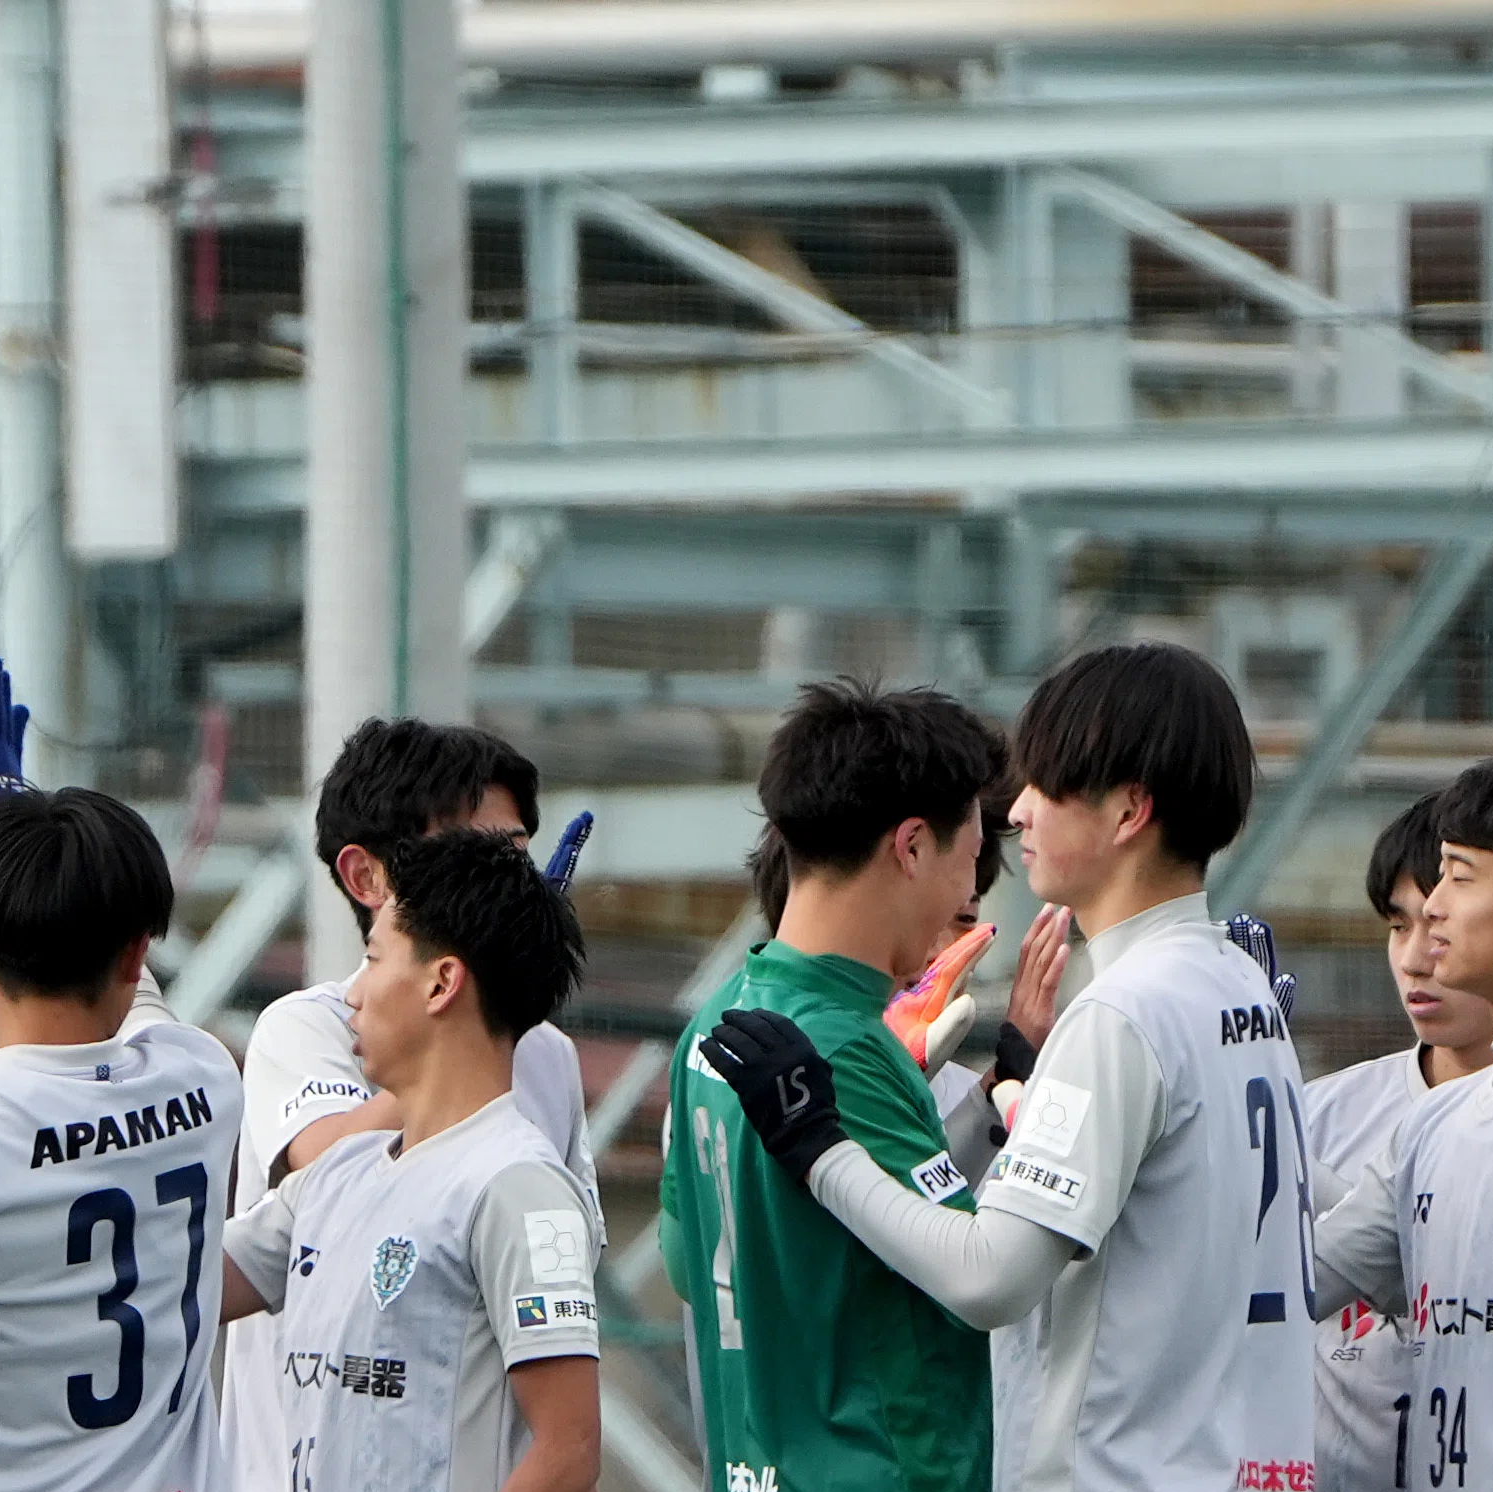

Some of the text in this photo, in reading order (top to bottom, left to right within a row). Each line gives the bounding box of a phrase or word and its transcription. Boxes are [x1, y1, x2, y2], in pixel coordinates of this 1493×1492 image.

[30, 1086, 213, 1170] APAMAN
[1010, 1159, 1081, 1199] 東洋建工
[65, 1161, 209, 1431] 37
[1429, 1386, 1468, 1489] 34
